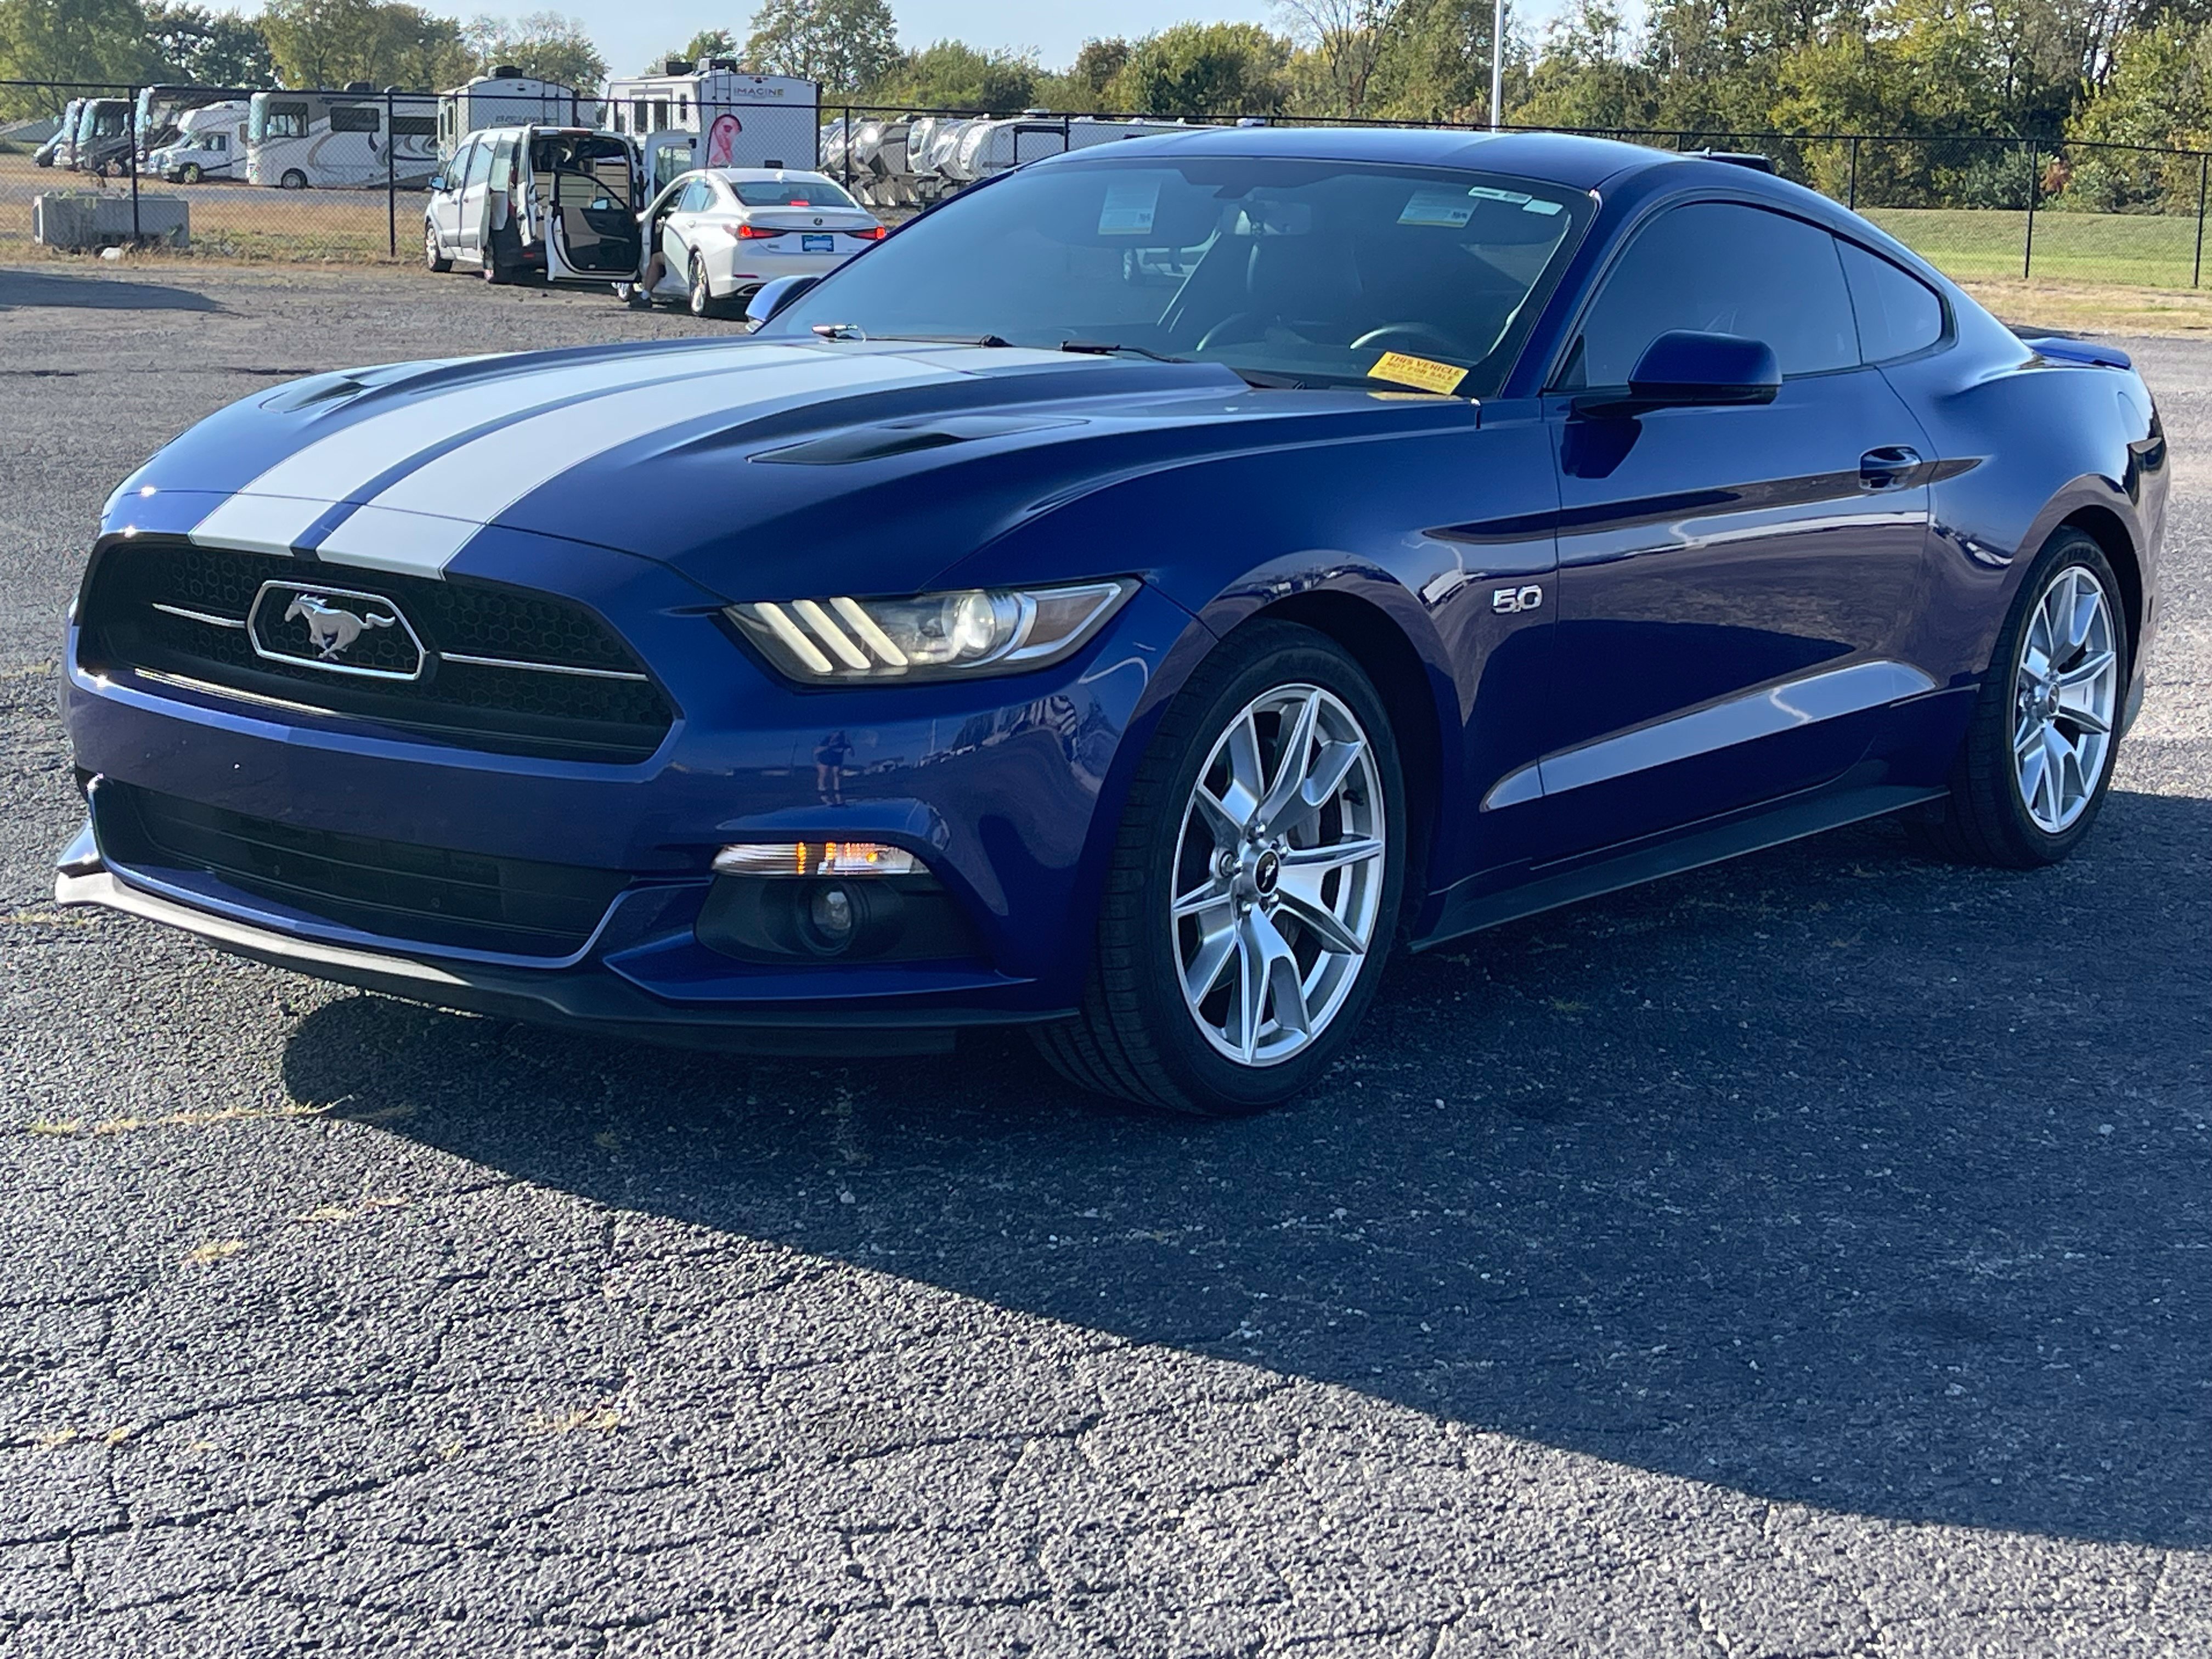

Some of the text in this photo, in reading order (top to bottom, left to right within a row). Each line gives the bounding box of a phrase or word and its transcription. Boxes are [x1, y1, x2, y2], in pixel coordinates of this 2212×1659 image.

[733, 87, 784, 96] IMAGINE
[1386, 361, 1406, 370] NOT
[1407, 366, 1427, 375] FOR
[1429, 371, 1455, 381] SALE
[1389, 355, 1414, 365] THIS
[1417, 360, 1461, 376] VEHICLE
[1492, 585, 1543, 613] 5.0
